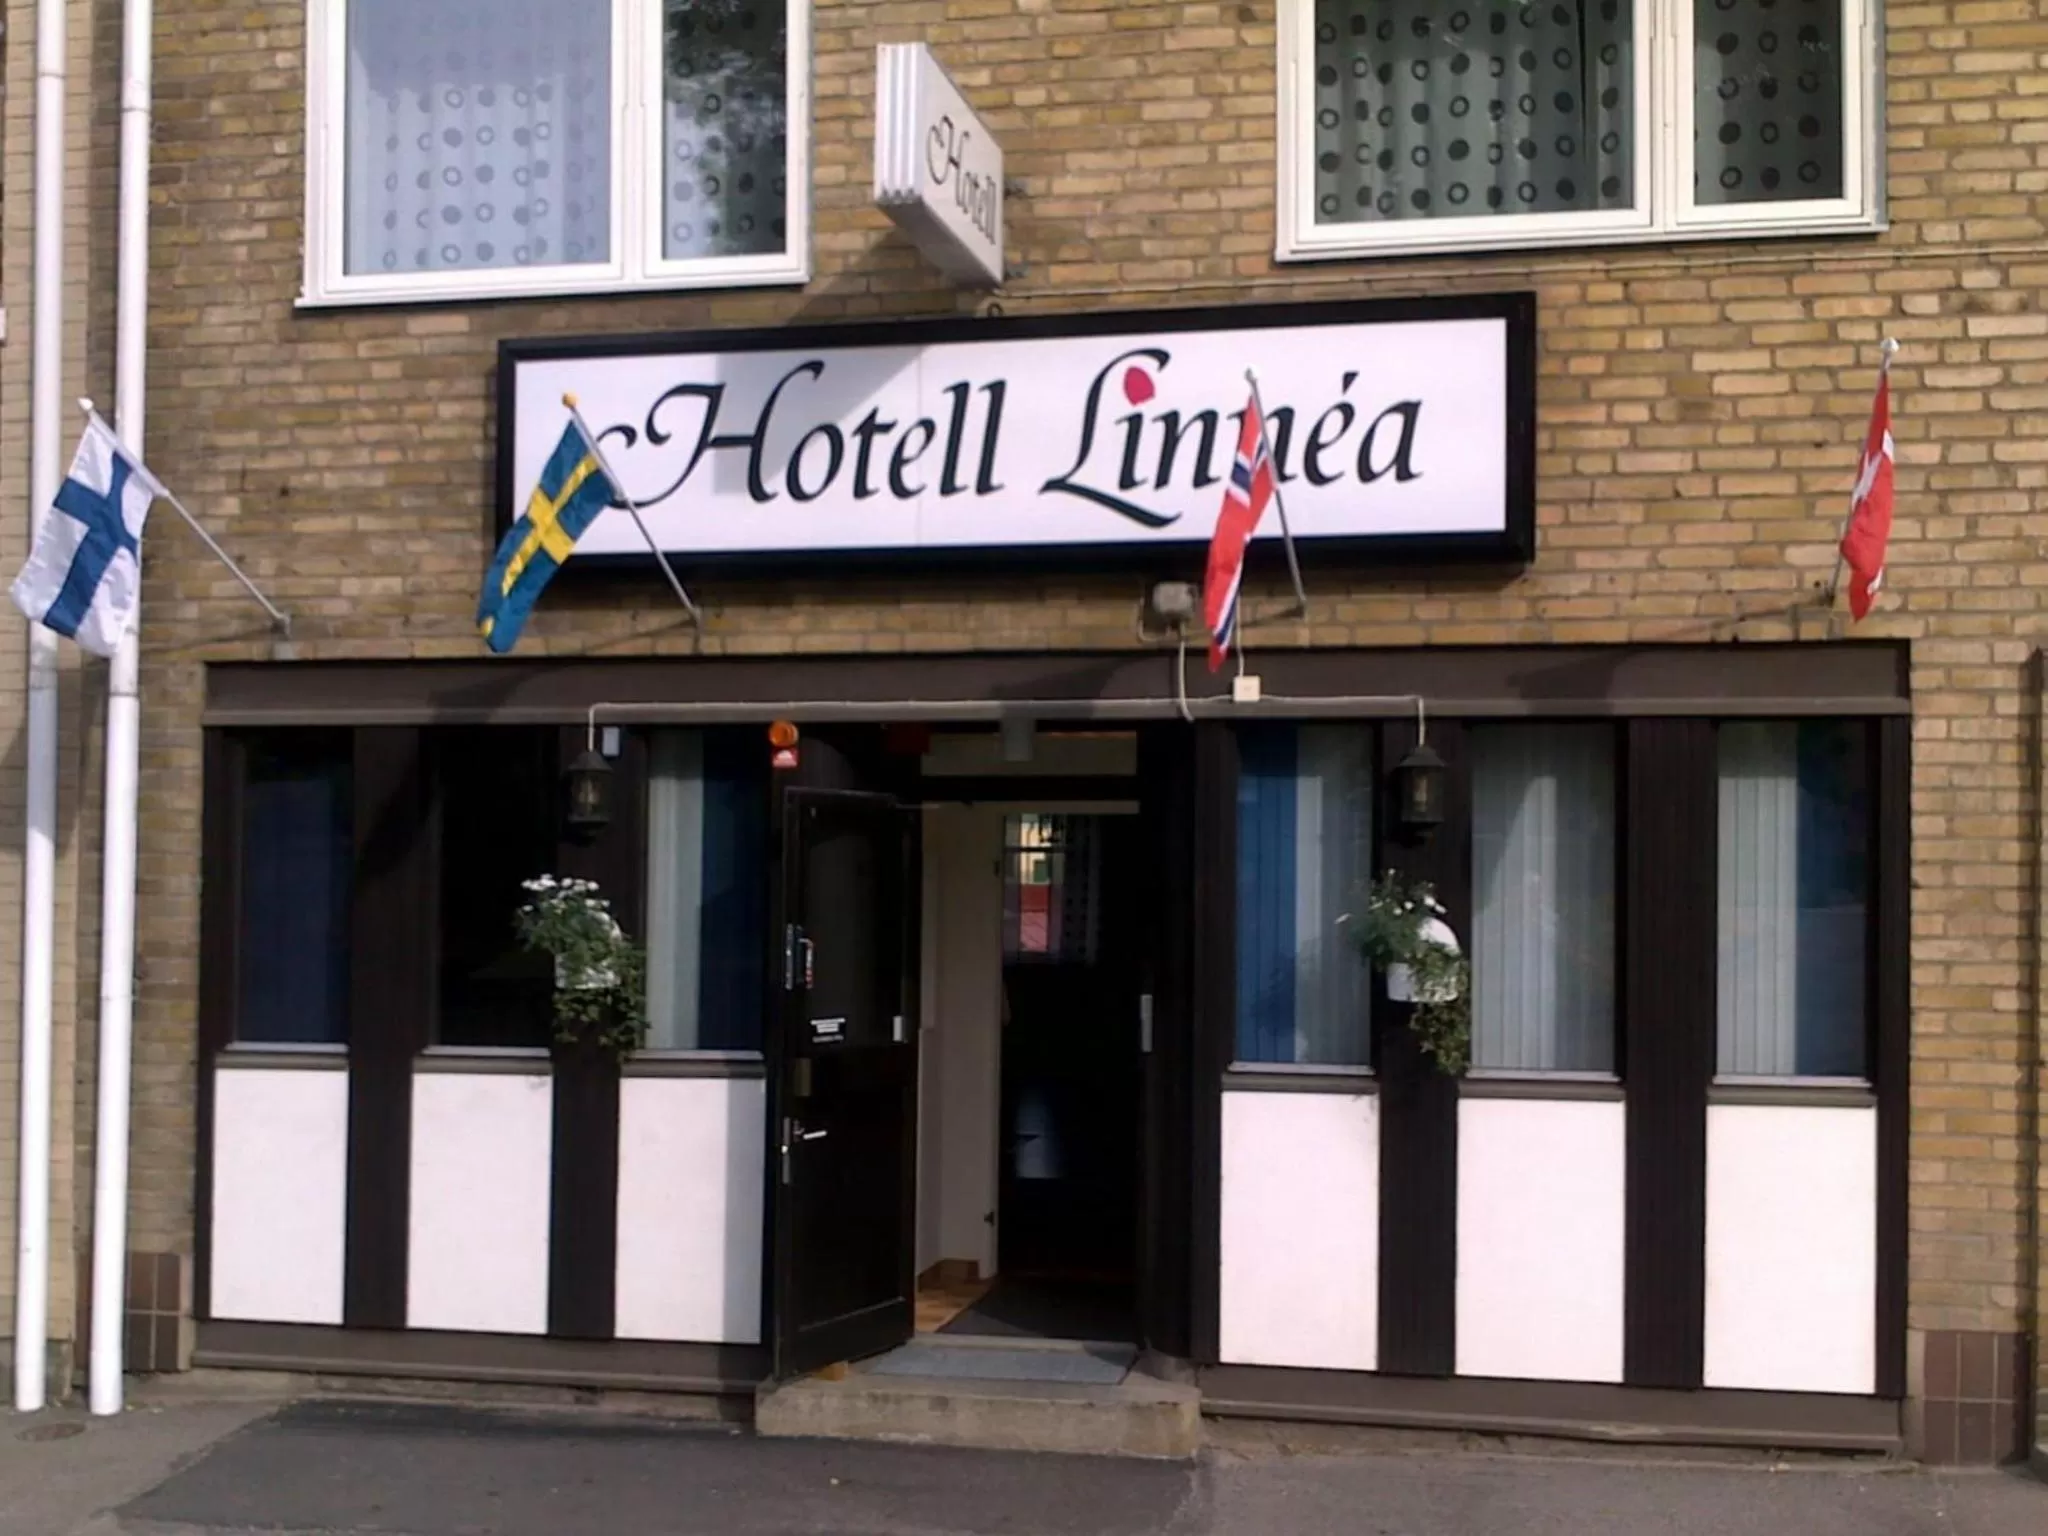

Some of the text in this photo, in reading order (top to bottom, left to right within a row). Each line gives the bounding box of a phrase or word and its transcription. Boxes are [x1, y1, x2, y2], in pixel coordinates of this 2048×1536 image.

[926, 113, 997, 246] Hotell
[597, 347, 1424, 528] Hotell Linnéa
